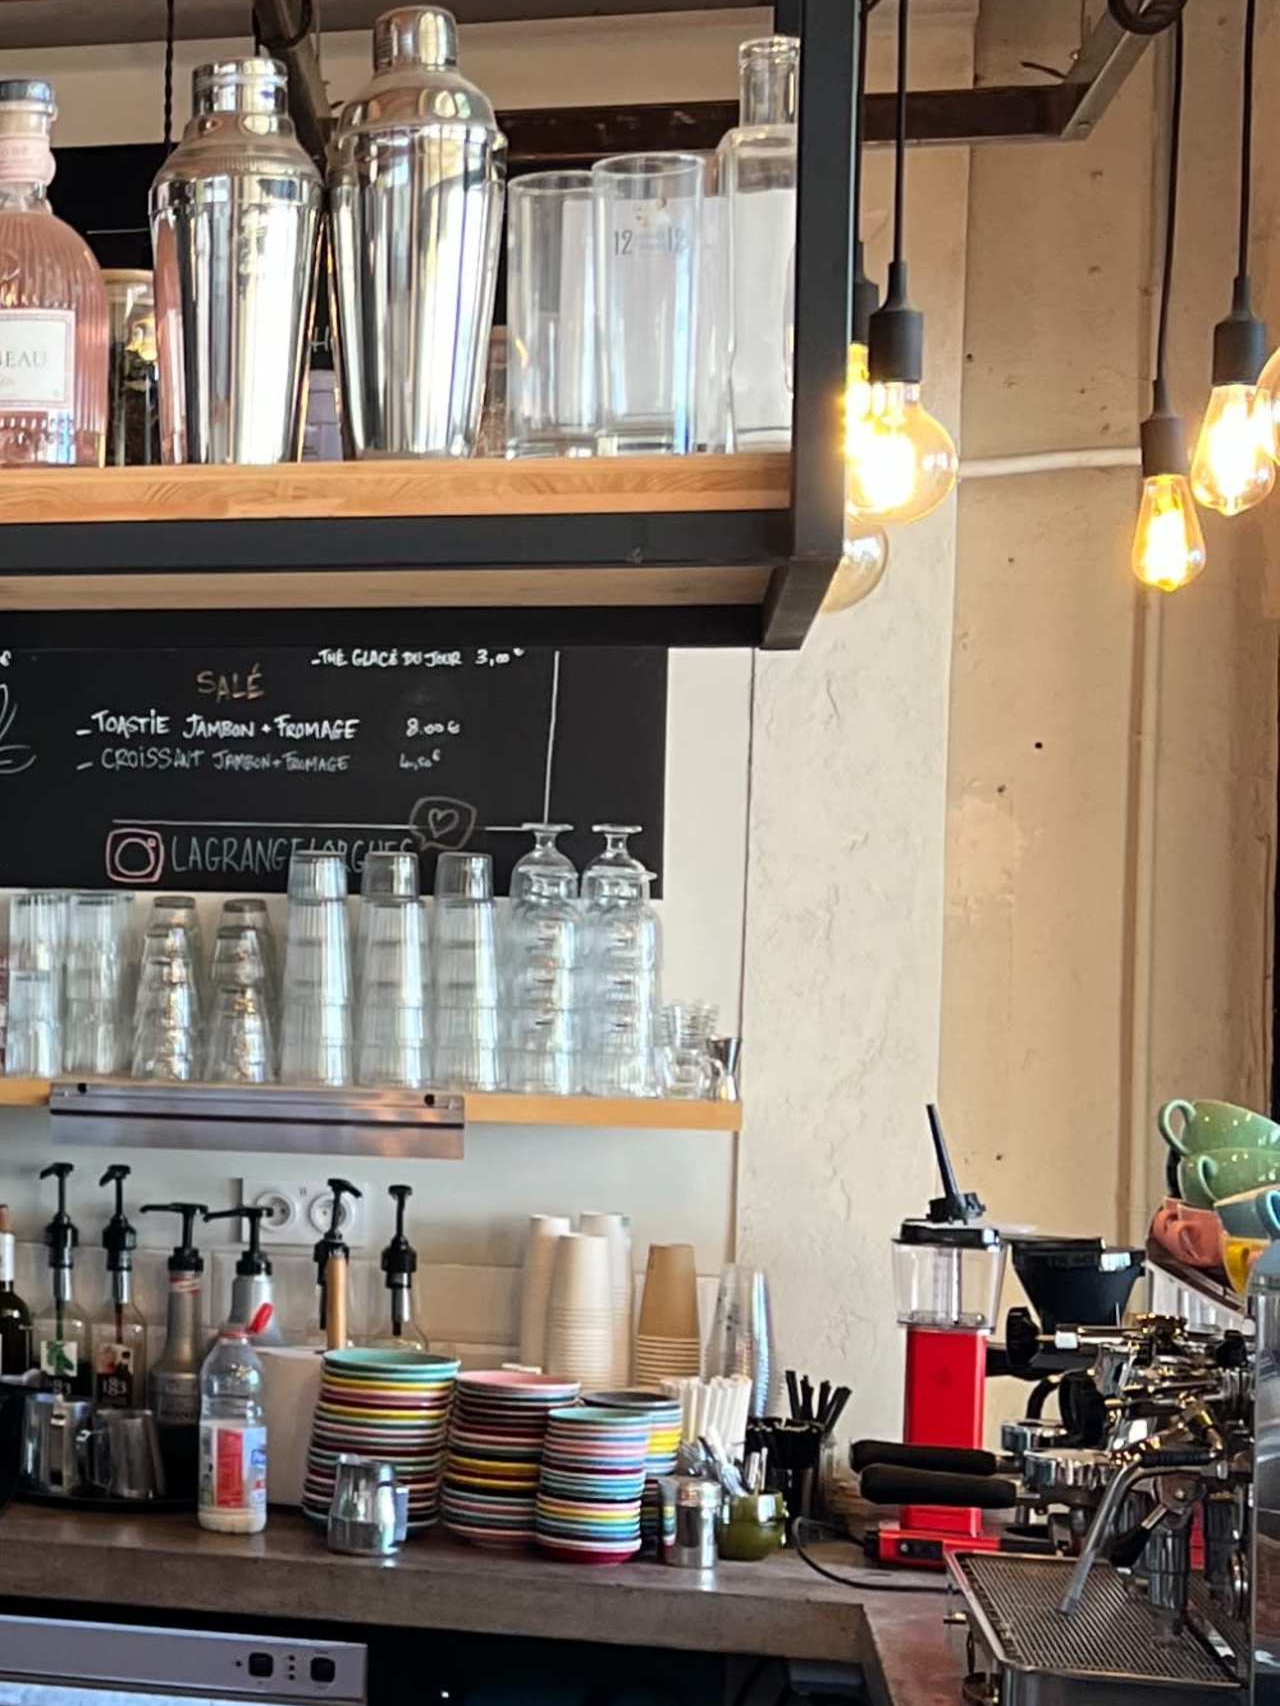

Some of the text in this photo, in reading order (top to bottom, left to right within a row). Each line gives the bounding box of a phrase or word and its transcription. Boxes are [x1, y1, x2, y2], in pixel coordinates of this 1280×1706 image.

[196, 663, 265, 704] SALÉ
[91, 708, 172, 740] TOASTIE
[181, 713, 256, 740] JAMBON
[273, 713, 360, 740] FROMAGE
[101, 746, 205, 772] CROISSANT
